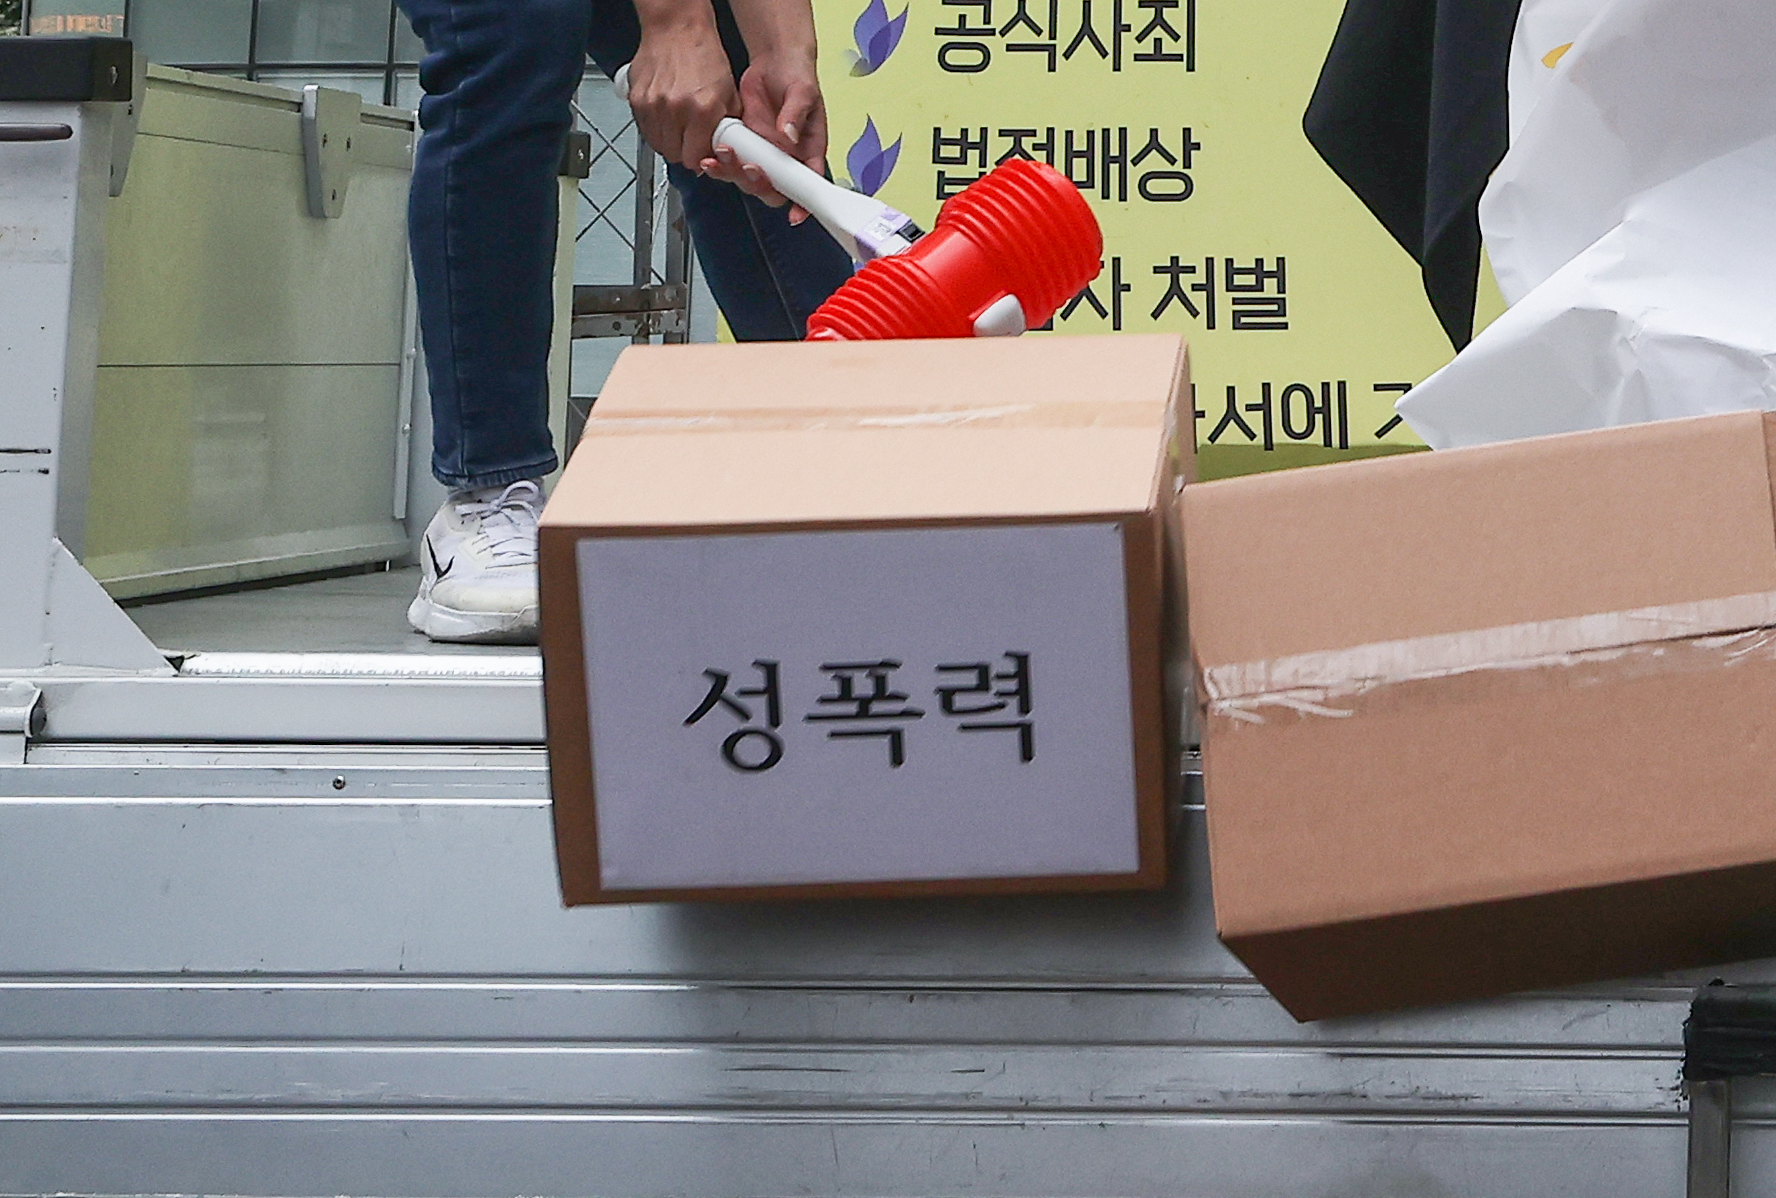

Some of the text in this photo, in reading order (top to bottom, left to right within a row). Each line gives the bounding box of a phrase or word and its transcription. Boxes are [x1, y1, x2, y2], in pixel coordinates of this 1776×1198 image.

[1150, 255, 1289, 331] 처벌
[1194, 379, 1349, 452] 서에
[682, 651, 1036, 772] 성폭력
